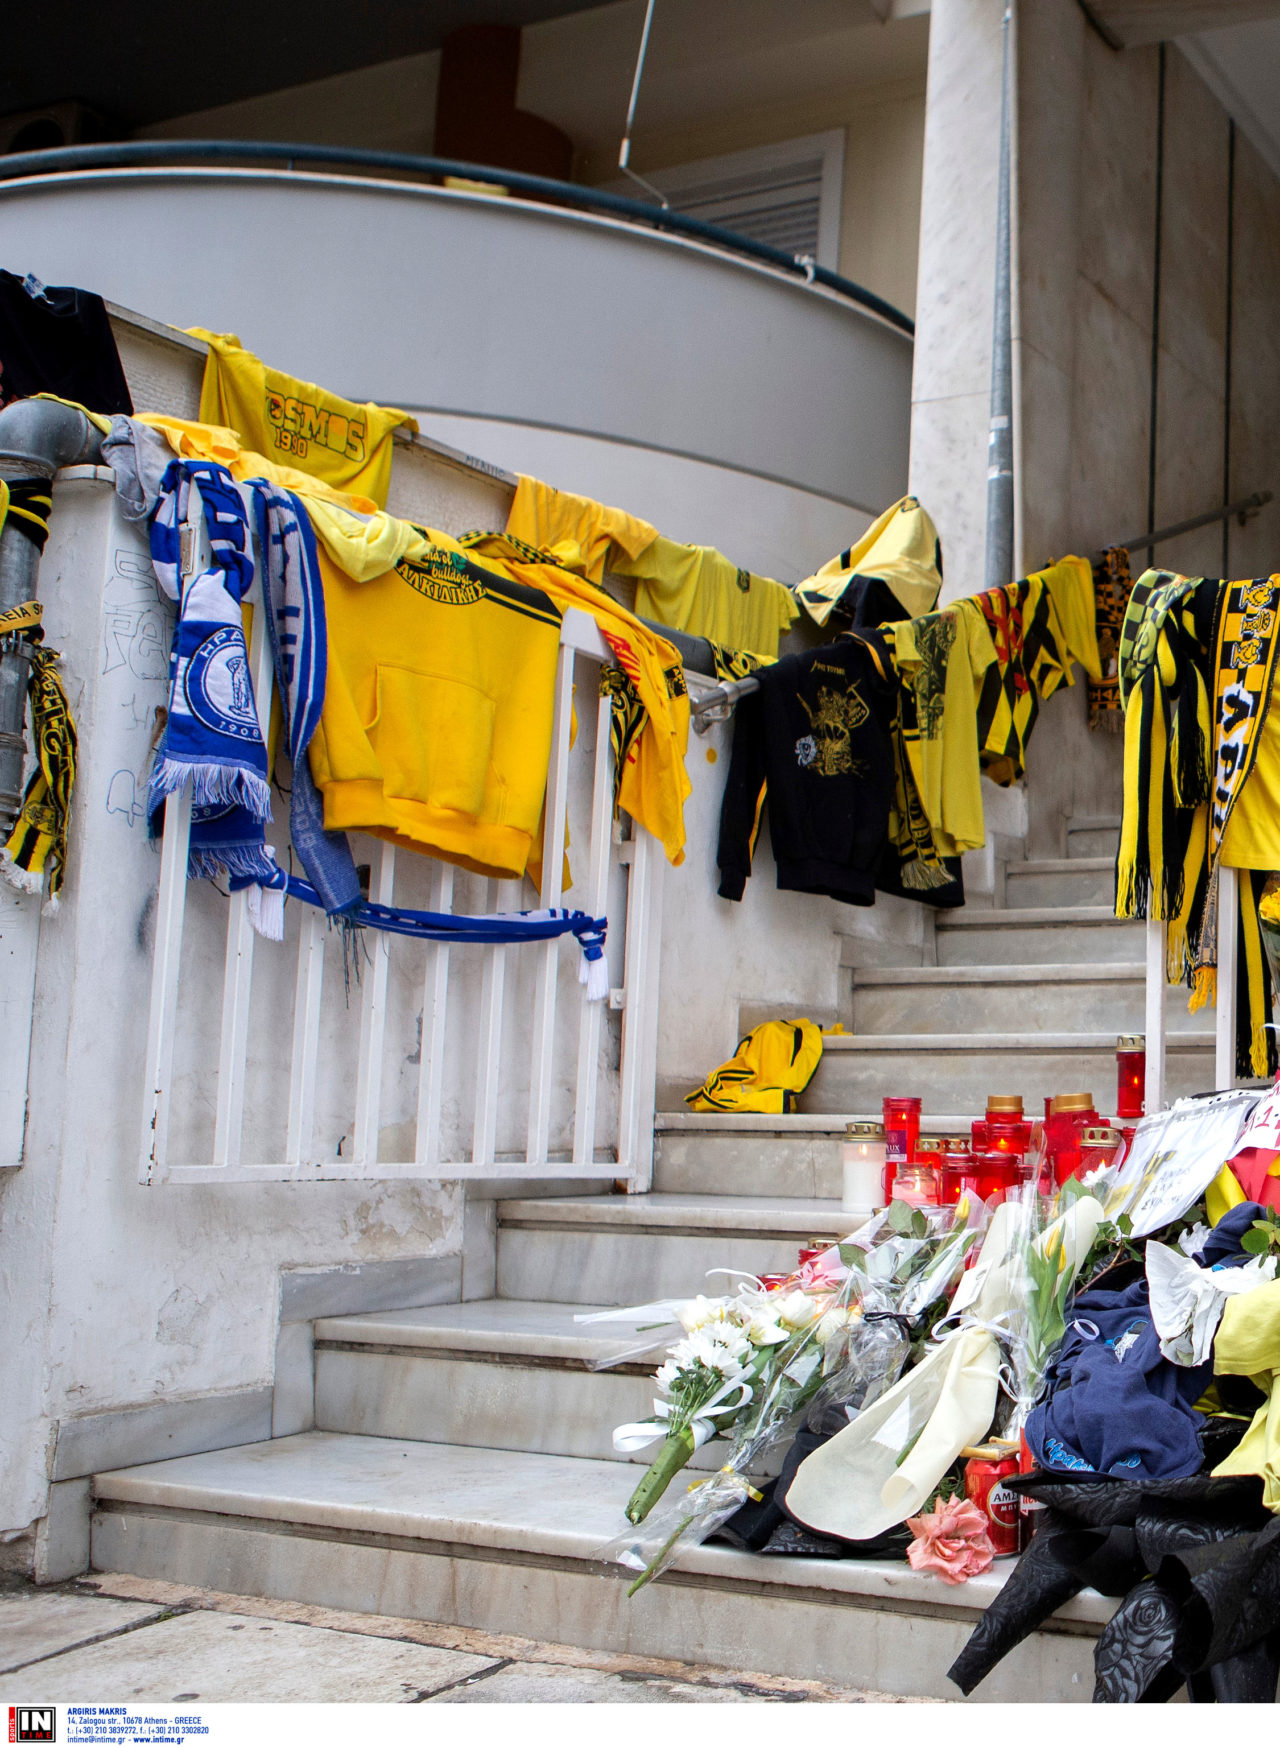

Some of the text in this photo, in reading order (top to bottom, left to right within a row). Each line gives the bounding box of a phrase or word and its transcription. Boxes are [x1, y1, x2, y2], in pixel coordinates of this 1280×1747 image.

[274, 427, 308, 459] 1990
[398, 562, 487, 605] ΑΛΚΙΔΙΚΗΣ
[201, 627, 245, 658] ΗΡΑ
[218, 720, 260, 740] 1908
